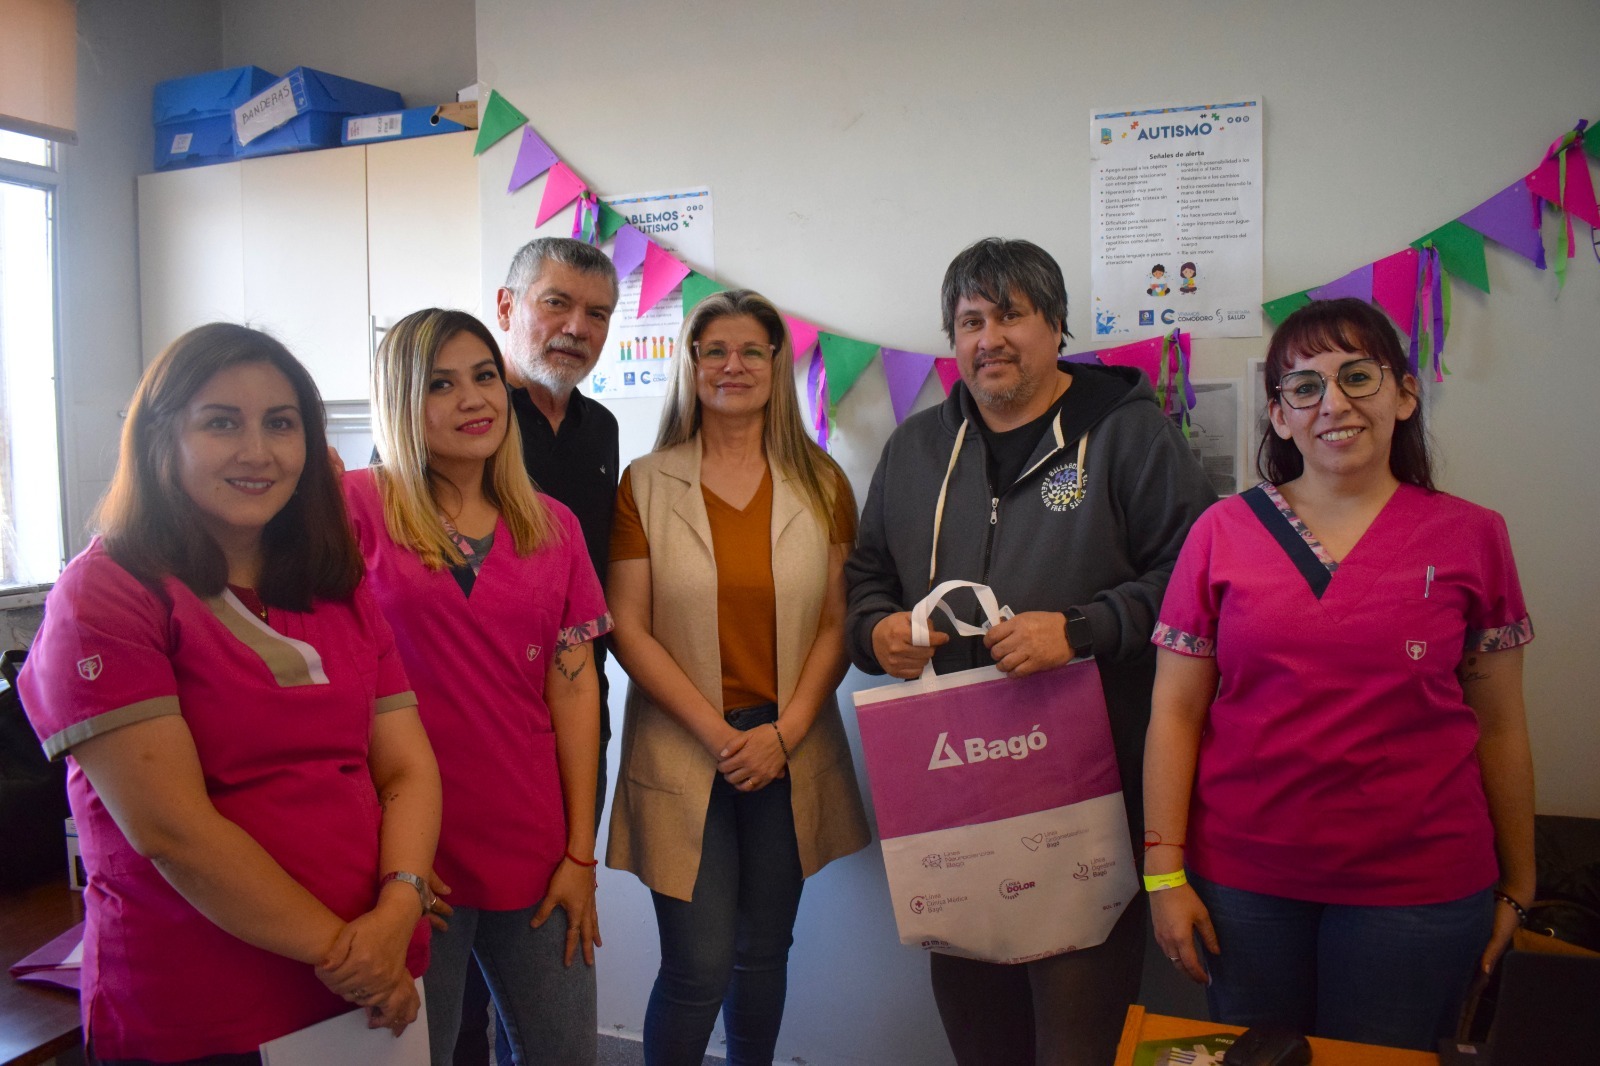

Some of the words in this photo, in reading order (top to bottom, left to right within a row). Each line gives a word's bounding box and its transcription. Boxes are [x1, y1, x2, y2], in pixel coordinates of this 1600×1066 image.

[242, 85, 290, 125] BANDERAS
[1137, 123, 1212, 140] AUTISMO
[1149, 152, 1174, 160] Señales
[637, 222, 679, 234] UTISMO
[964, 723, 1048, 764] Bagó
[1006, 881, 1036, 893] DOLOR
